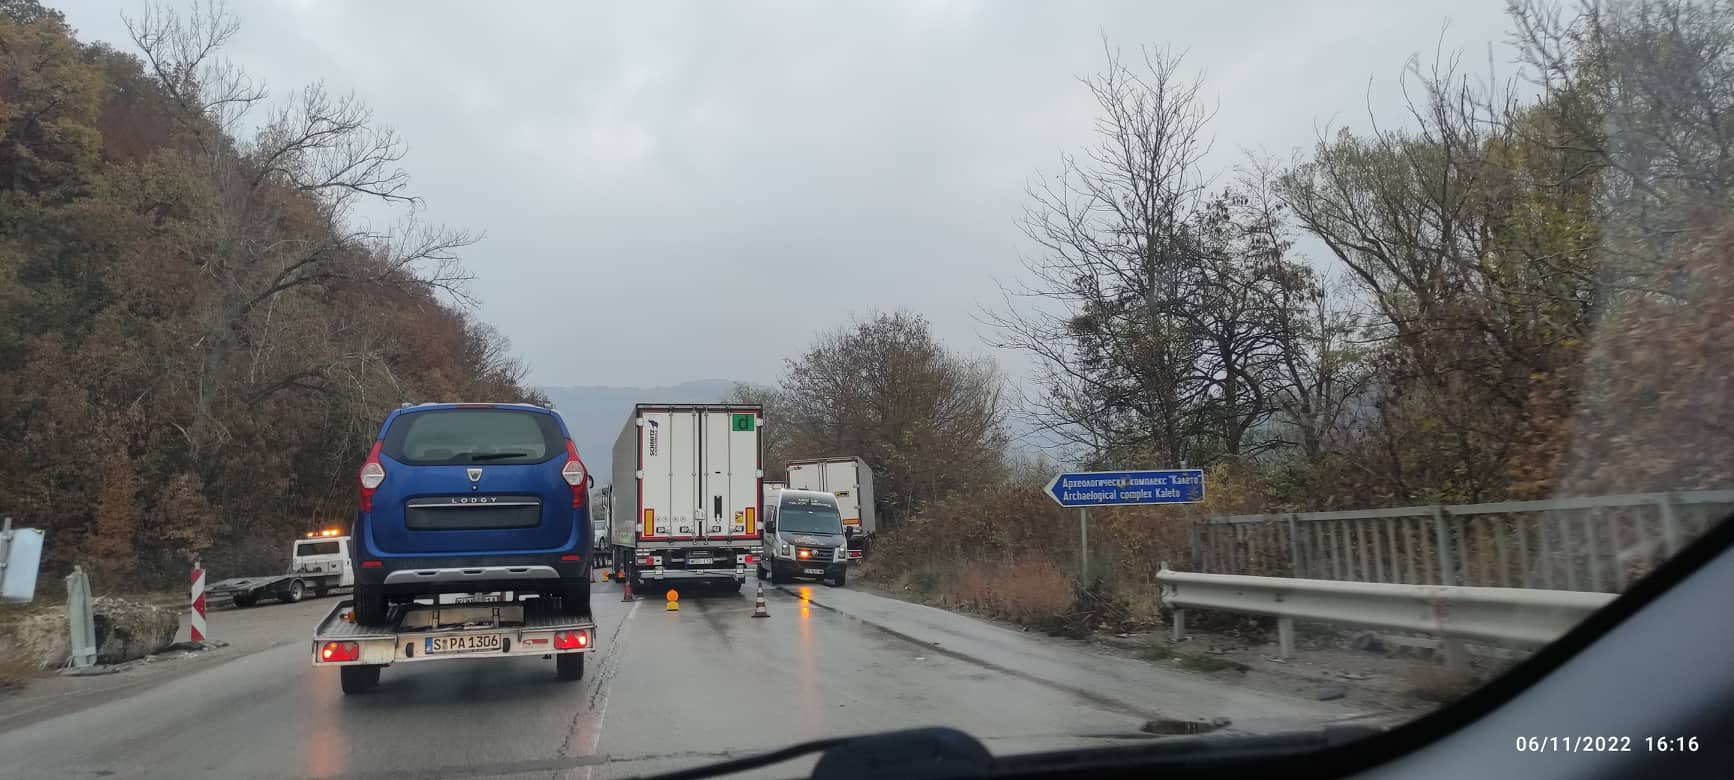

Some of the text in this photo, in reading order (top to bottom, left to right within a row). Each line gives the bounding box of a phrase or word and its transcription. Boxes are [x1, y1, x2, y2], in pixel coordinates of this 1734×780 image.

[738, 416, 748, 431] d
[1131, 477, 1168, 486] комплекс
[1063, 488, 1181, 502] Archaelogical complex Kaleto
[433, 635, 498, 650] S PA 1306
